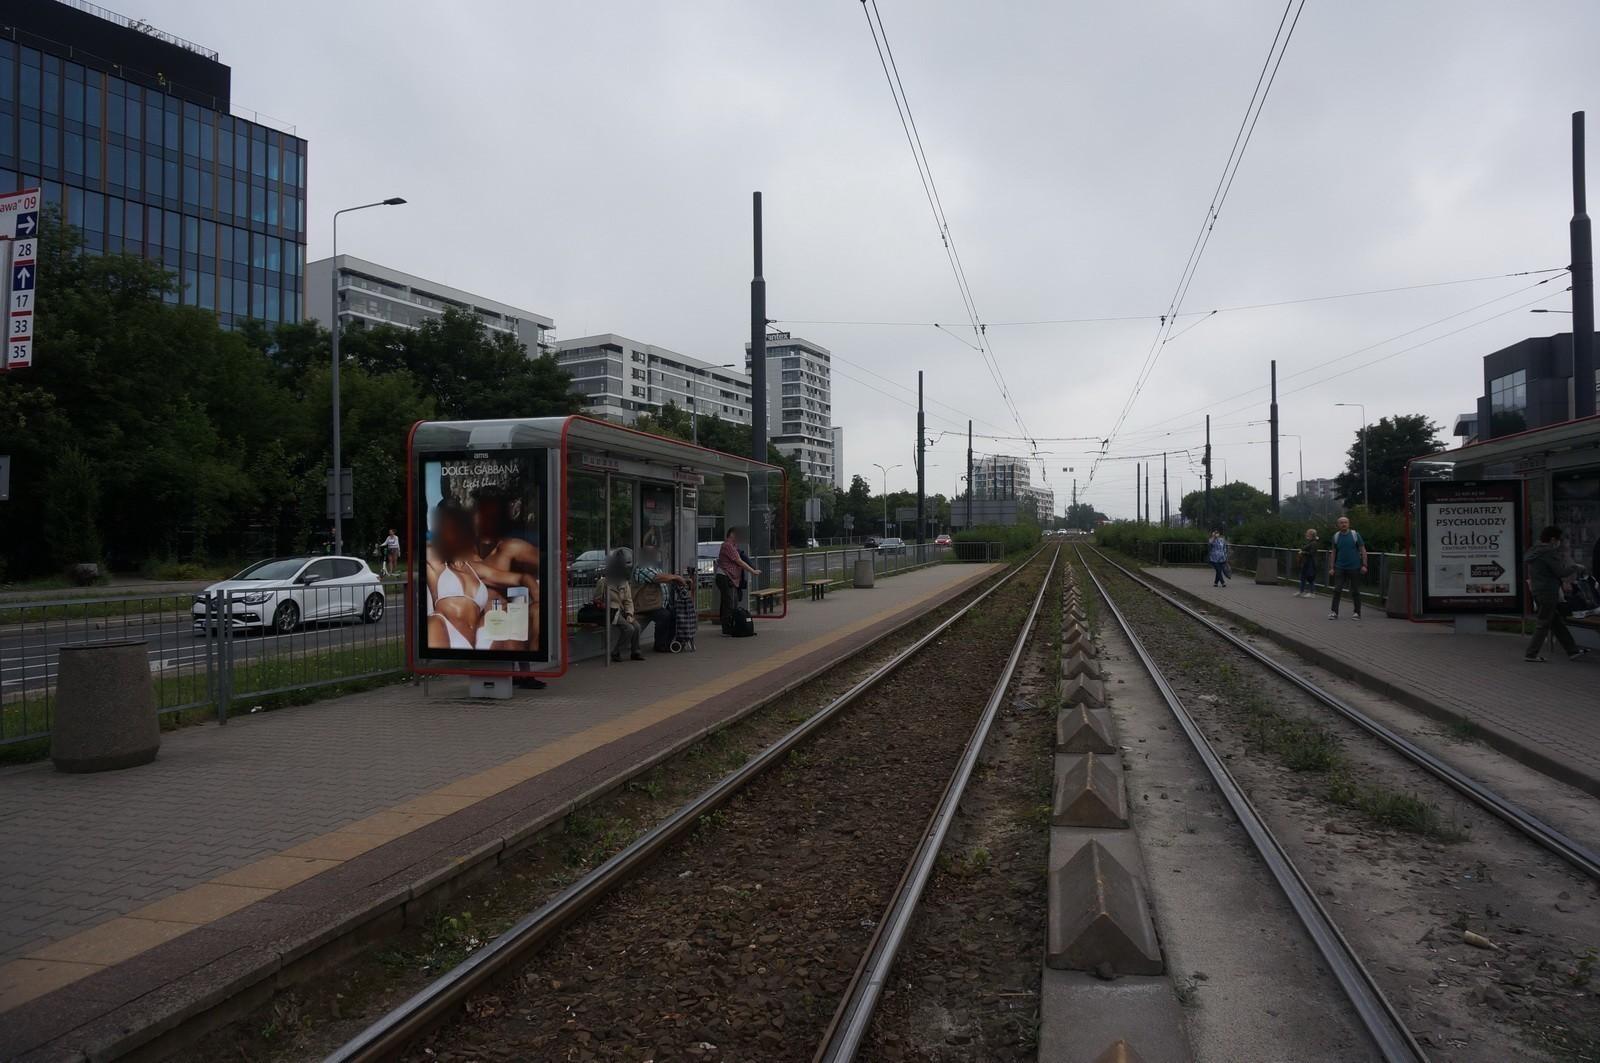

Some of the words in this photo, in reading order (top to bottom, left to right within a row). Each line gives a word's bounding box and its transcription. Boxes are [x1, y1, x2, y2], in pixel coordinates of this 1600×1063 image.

[0, 200, 21, 213] awa"
[24, 196, 36, 210] 09
[18, 243, 32, 257] 28
[16, 294, 29, 308] 17
[14, 320, 28, 333] 33
[13, 345, 26, 359] 35
[441, 466, 470, 476] DOLCE
[474, 464, 520, 475] GABBANA
[1439, 506, 1504, 515] PSYCHIATRZY
[1436, 518, 1506, 527] PSYCHOLODZY
